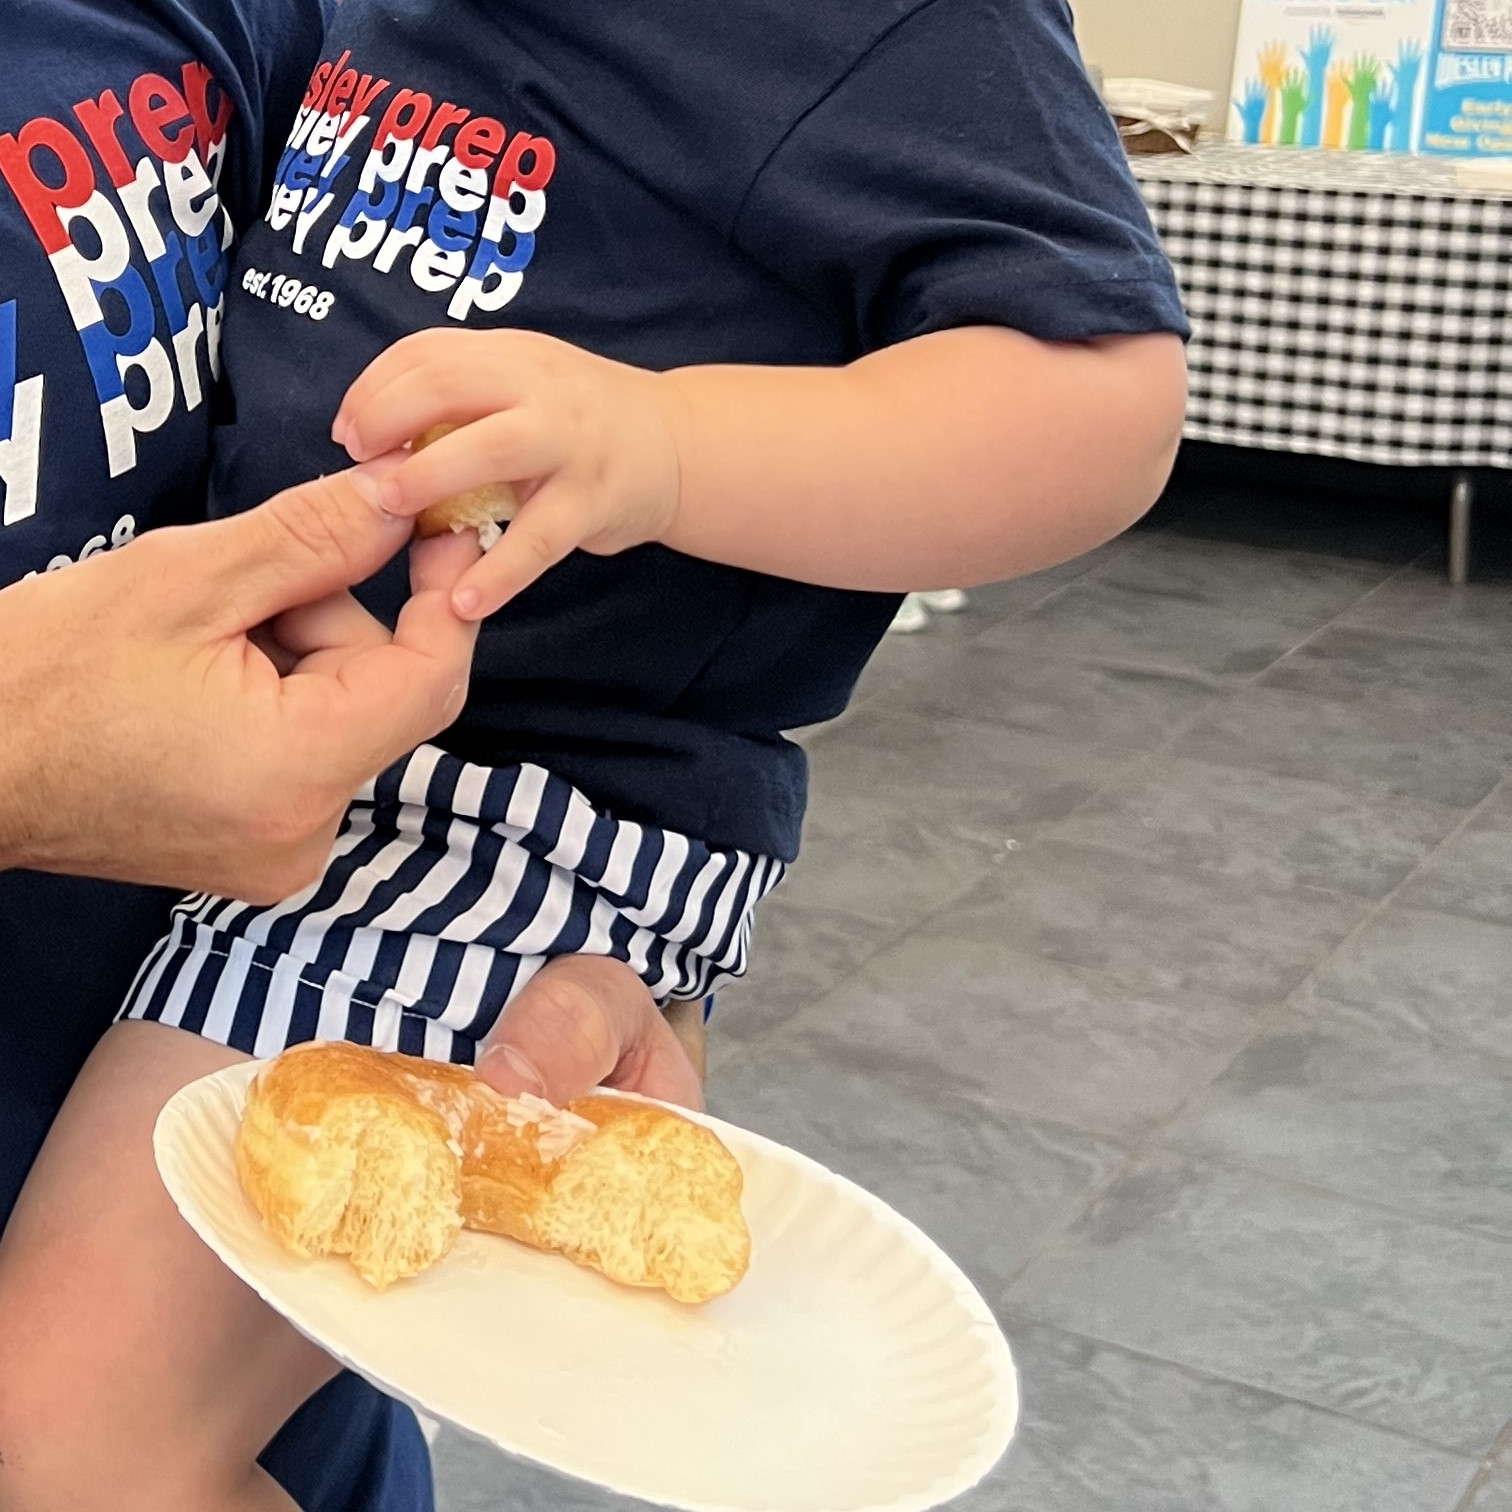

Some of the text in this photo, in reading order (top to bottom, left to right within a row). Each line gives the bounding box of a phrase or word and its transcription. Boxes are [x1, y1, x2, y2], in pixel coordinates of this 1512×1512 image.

[302, 50, 556, 201] sley prep
[339, 176, 536, 281] prep
[358, 123, 547, 244] prep
[270, 274, 336, 321] 1968
[321, 210, 524, 321] prep
